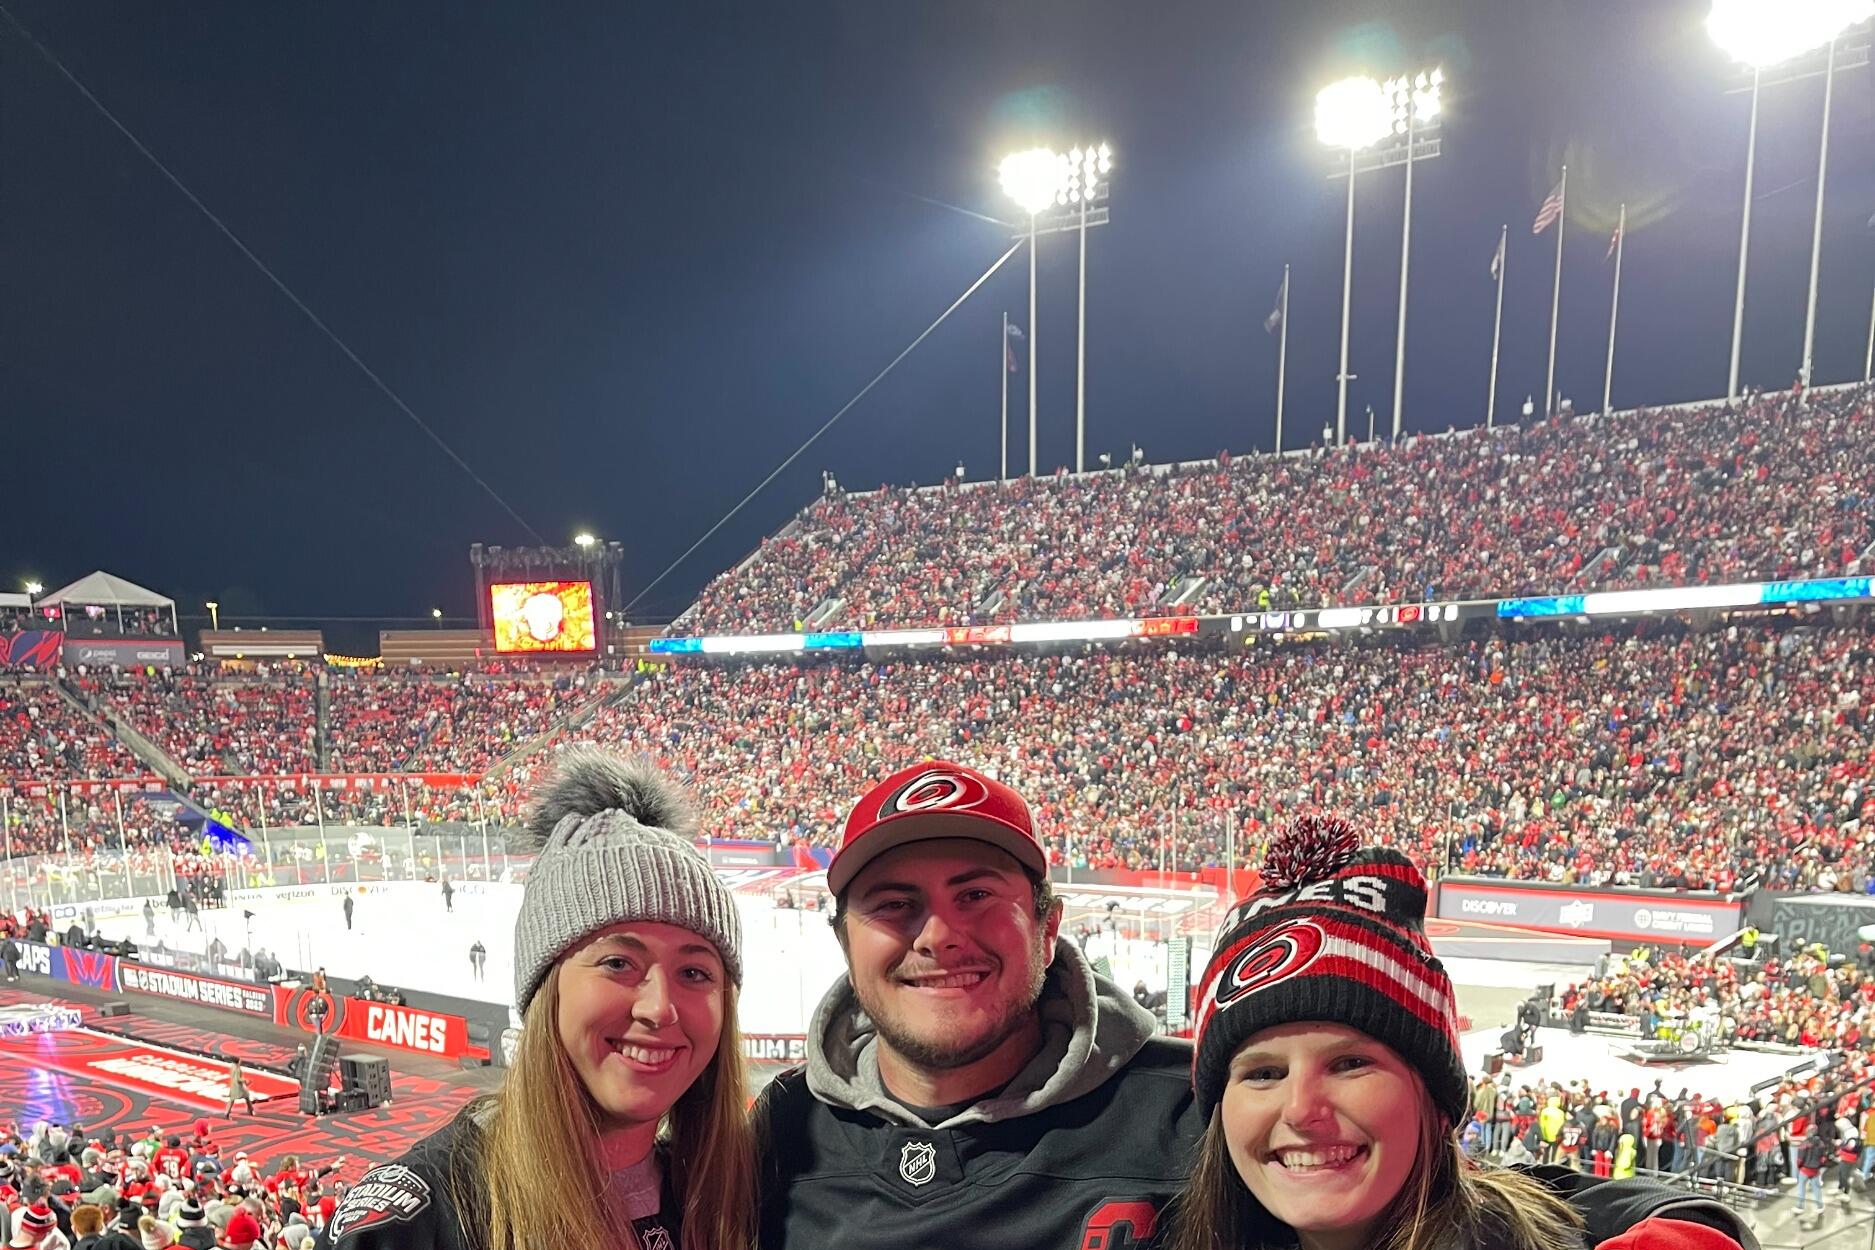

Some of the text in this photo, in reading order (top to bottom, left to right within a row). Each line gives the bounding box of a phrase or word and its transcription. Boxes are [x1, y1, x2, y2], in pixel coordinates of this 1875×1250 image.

[1461, 898, 1518, 916] DISCOVER
[148, 971, 200, 1001] STADIUM
[199, 981, 243, 1009] SERIES
[367, 1005, 447, 1054] CANES
[908, 1154, 928, 1175] NHL
[345, 1182, 422, 1214] STADIUM
